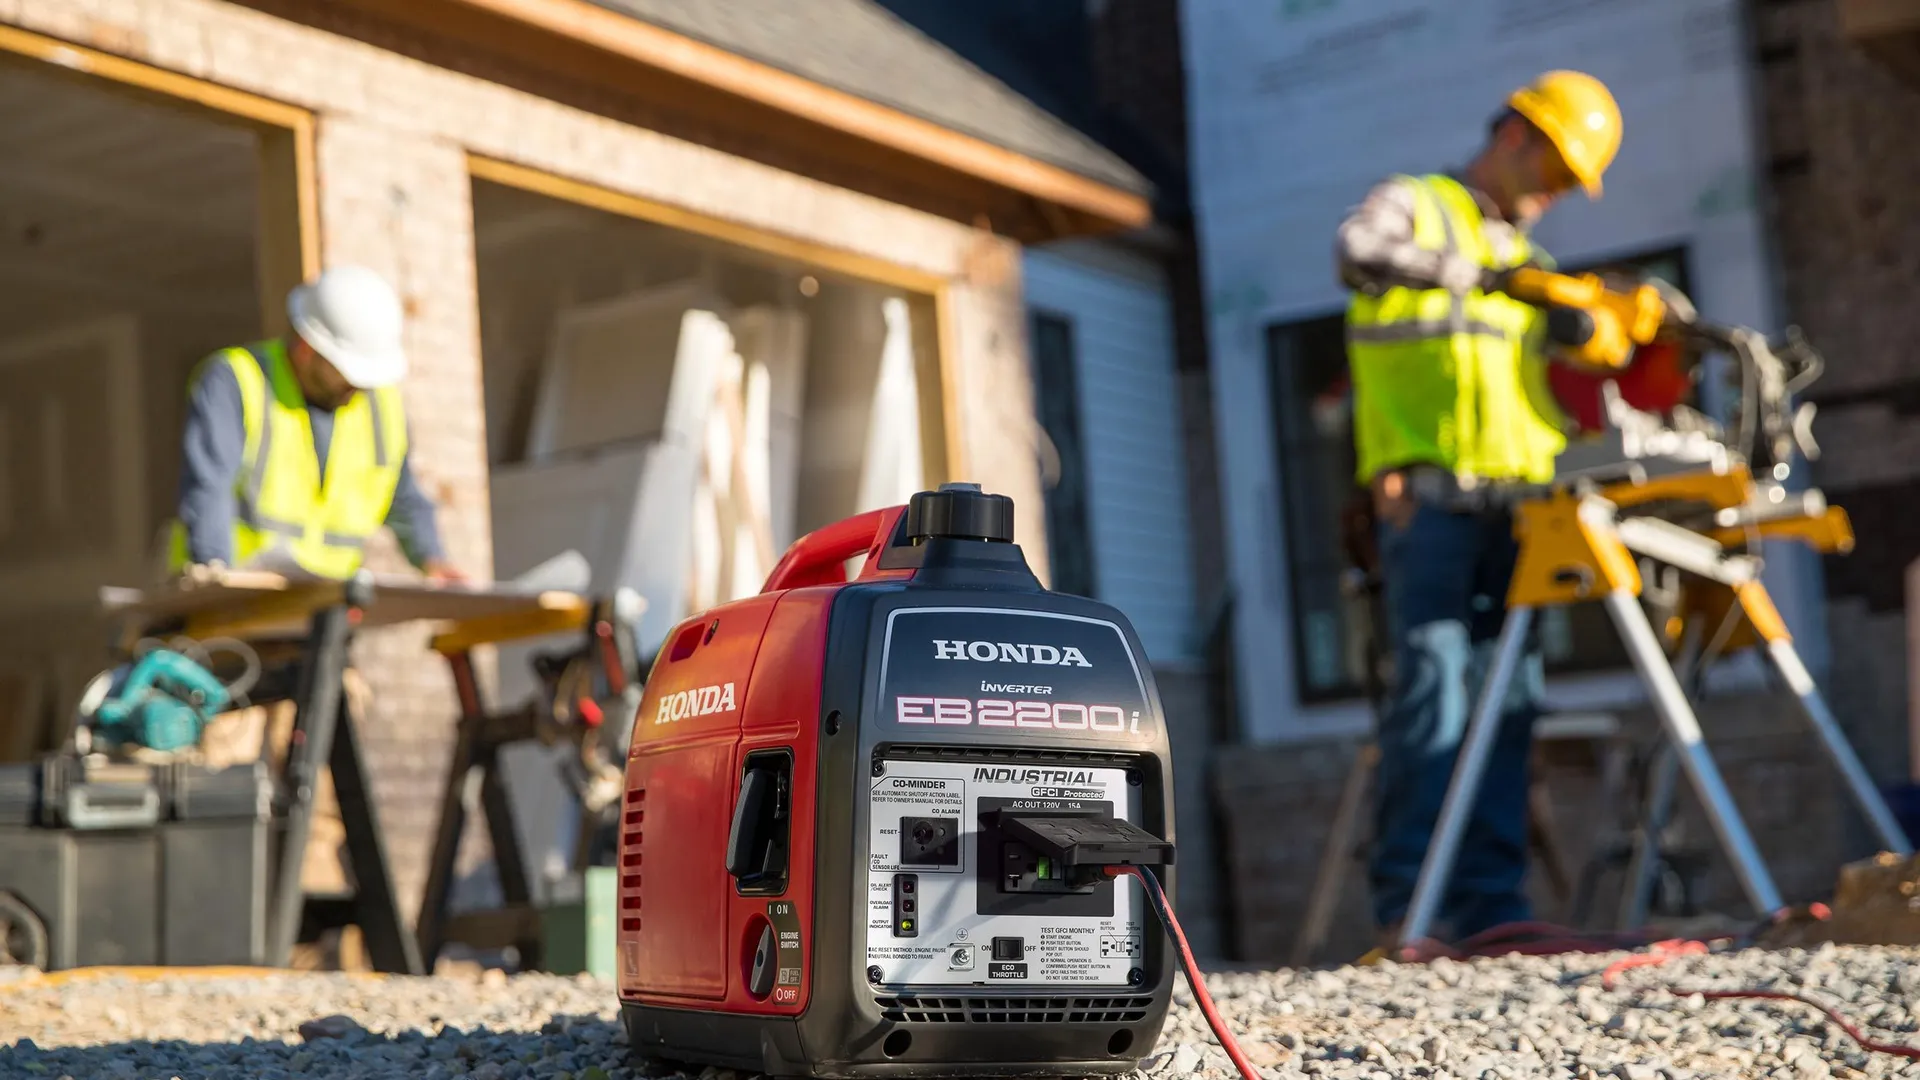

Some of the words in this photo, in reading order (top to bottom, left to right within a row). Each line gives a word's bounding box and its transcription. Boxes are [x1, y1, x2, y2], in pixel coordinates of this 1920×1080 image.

[933, 640, 1092, 668] HONDA
[655, 682, 736, 724] HONDA
[973, 768, 1107, 787] INDUSTRIAL
[892, 780, 946, 789] CO-MINDER
[1032, 787, 1059, 797] GFCI
[1063, 790, 1105, 799] Protected
[777, 904, 788, 914] ON
[784, 990, 796, 999] OFF
